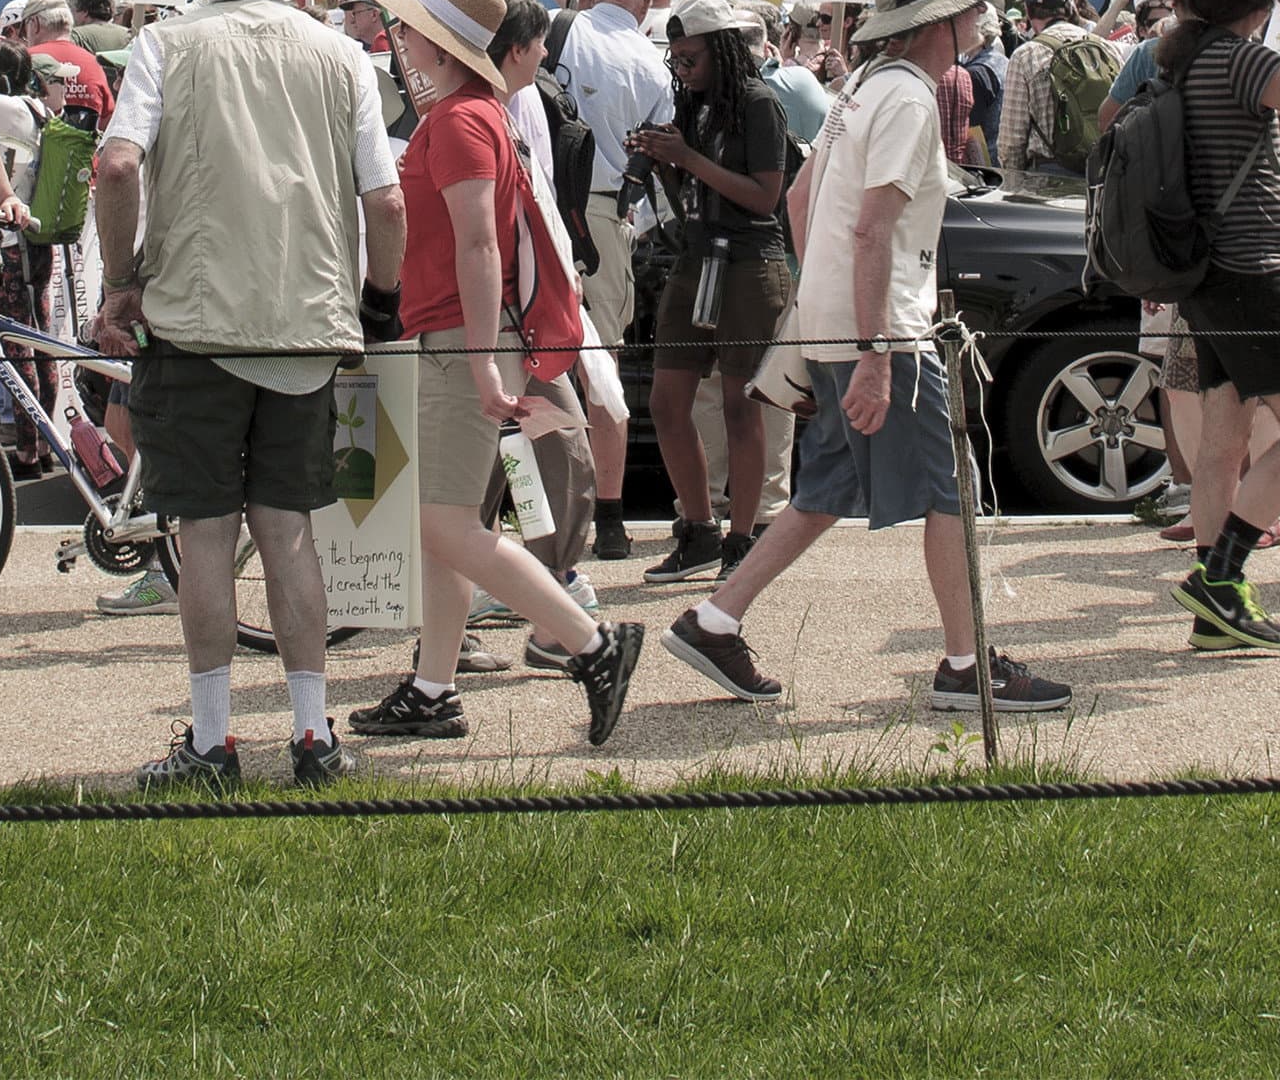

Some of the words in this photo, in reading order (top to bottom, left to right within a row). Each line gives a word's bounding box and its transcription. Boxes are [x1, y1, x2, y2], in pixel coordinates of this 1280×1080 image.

[328, 540, 347, 566] the
[336, 573, 379, 592] created
[381, 572, 401, 591] the
